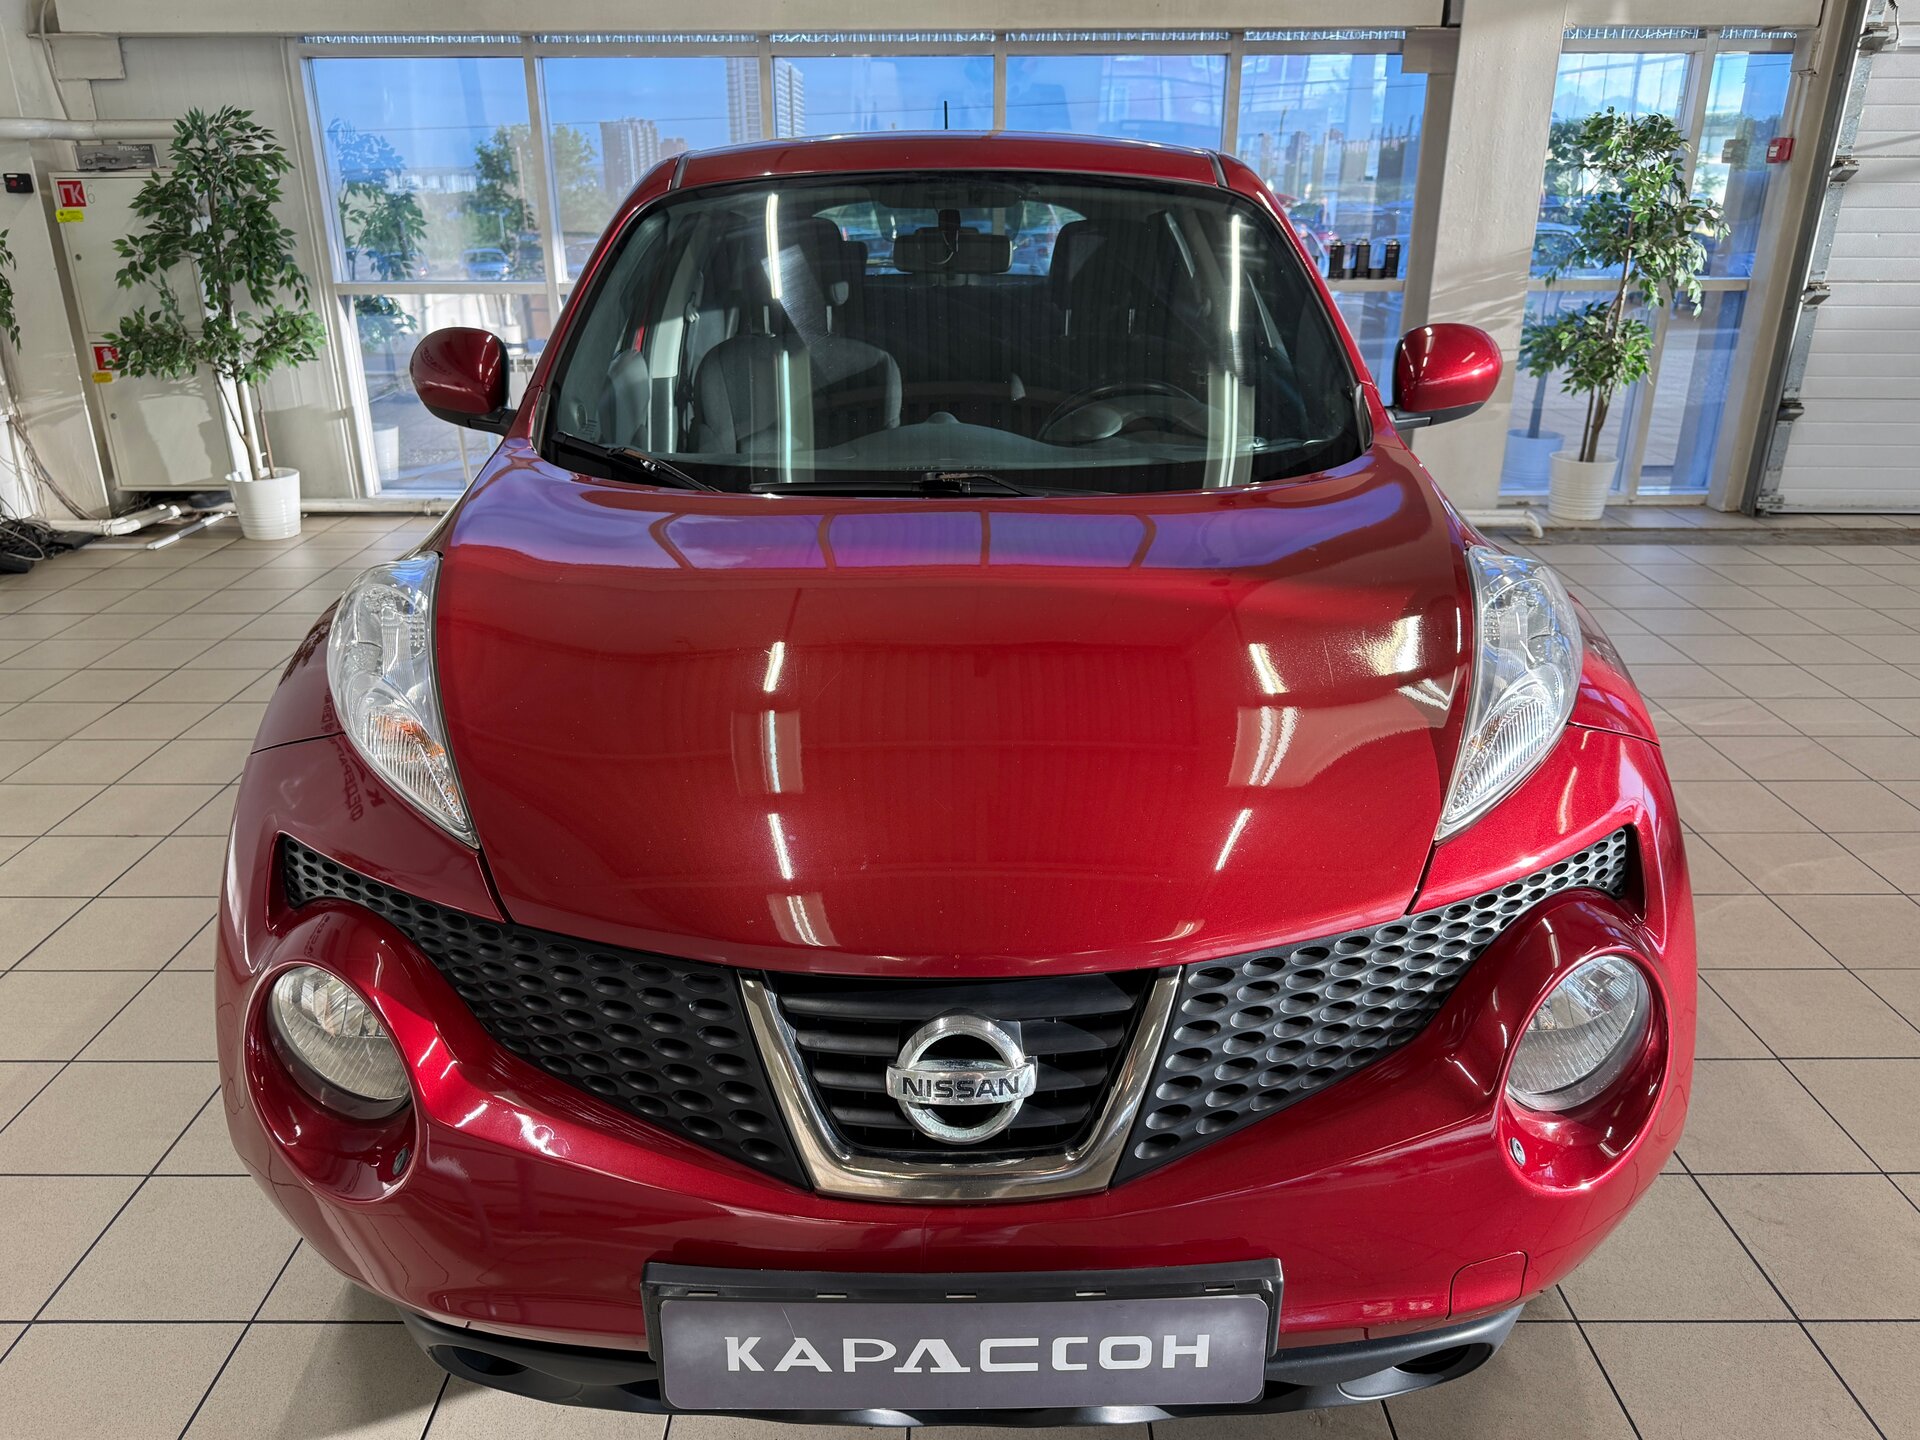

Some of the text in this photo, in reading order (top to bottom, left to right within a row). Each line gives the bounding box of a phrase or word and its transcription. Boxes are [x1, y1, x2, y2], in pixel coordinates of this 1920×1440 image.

[59, 184, 85, 204] ПК
[902, 1076, 1019, 1099] NISSAN
[724, 1334, 1210, 1373] КАРАССОН
